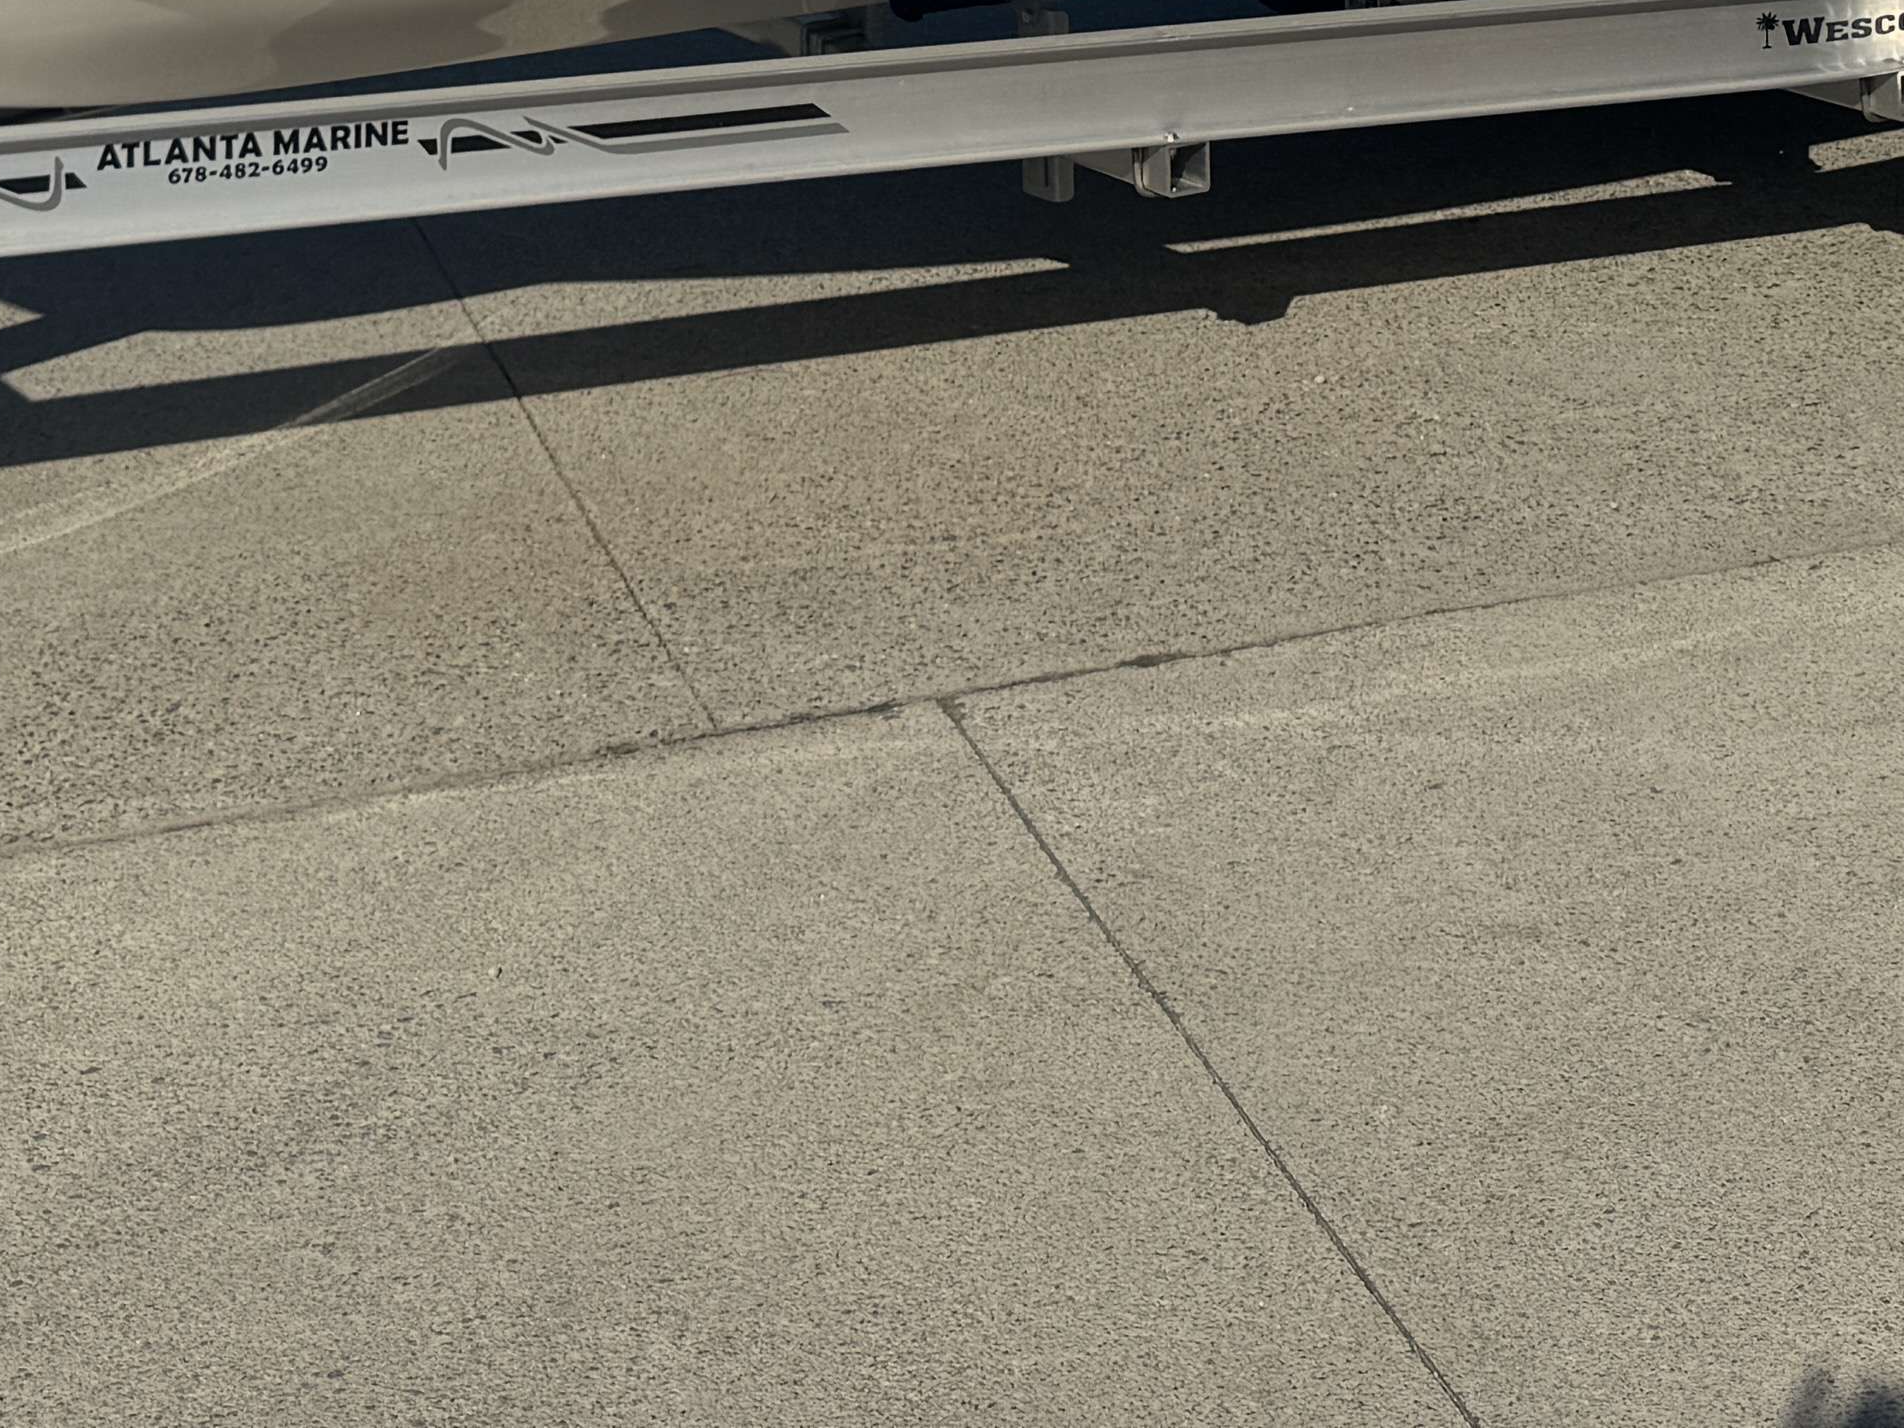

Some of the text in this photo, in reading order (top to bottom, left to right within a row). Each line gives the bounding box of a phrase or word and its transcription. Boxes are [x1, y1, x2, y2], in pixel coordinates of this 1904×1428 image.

[97, 120, 410, 171] ATLANTA MARINE
[167, 156, 329, 185] 678-482-6499
